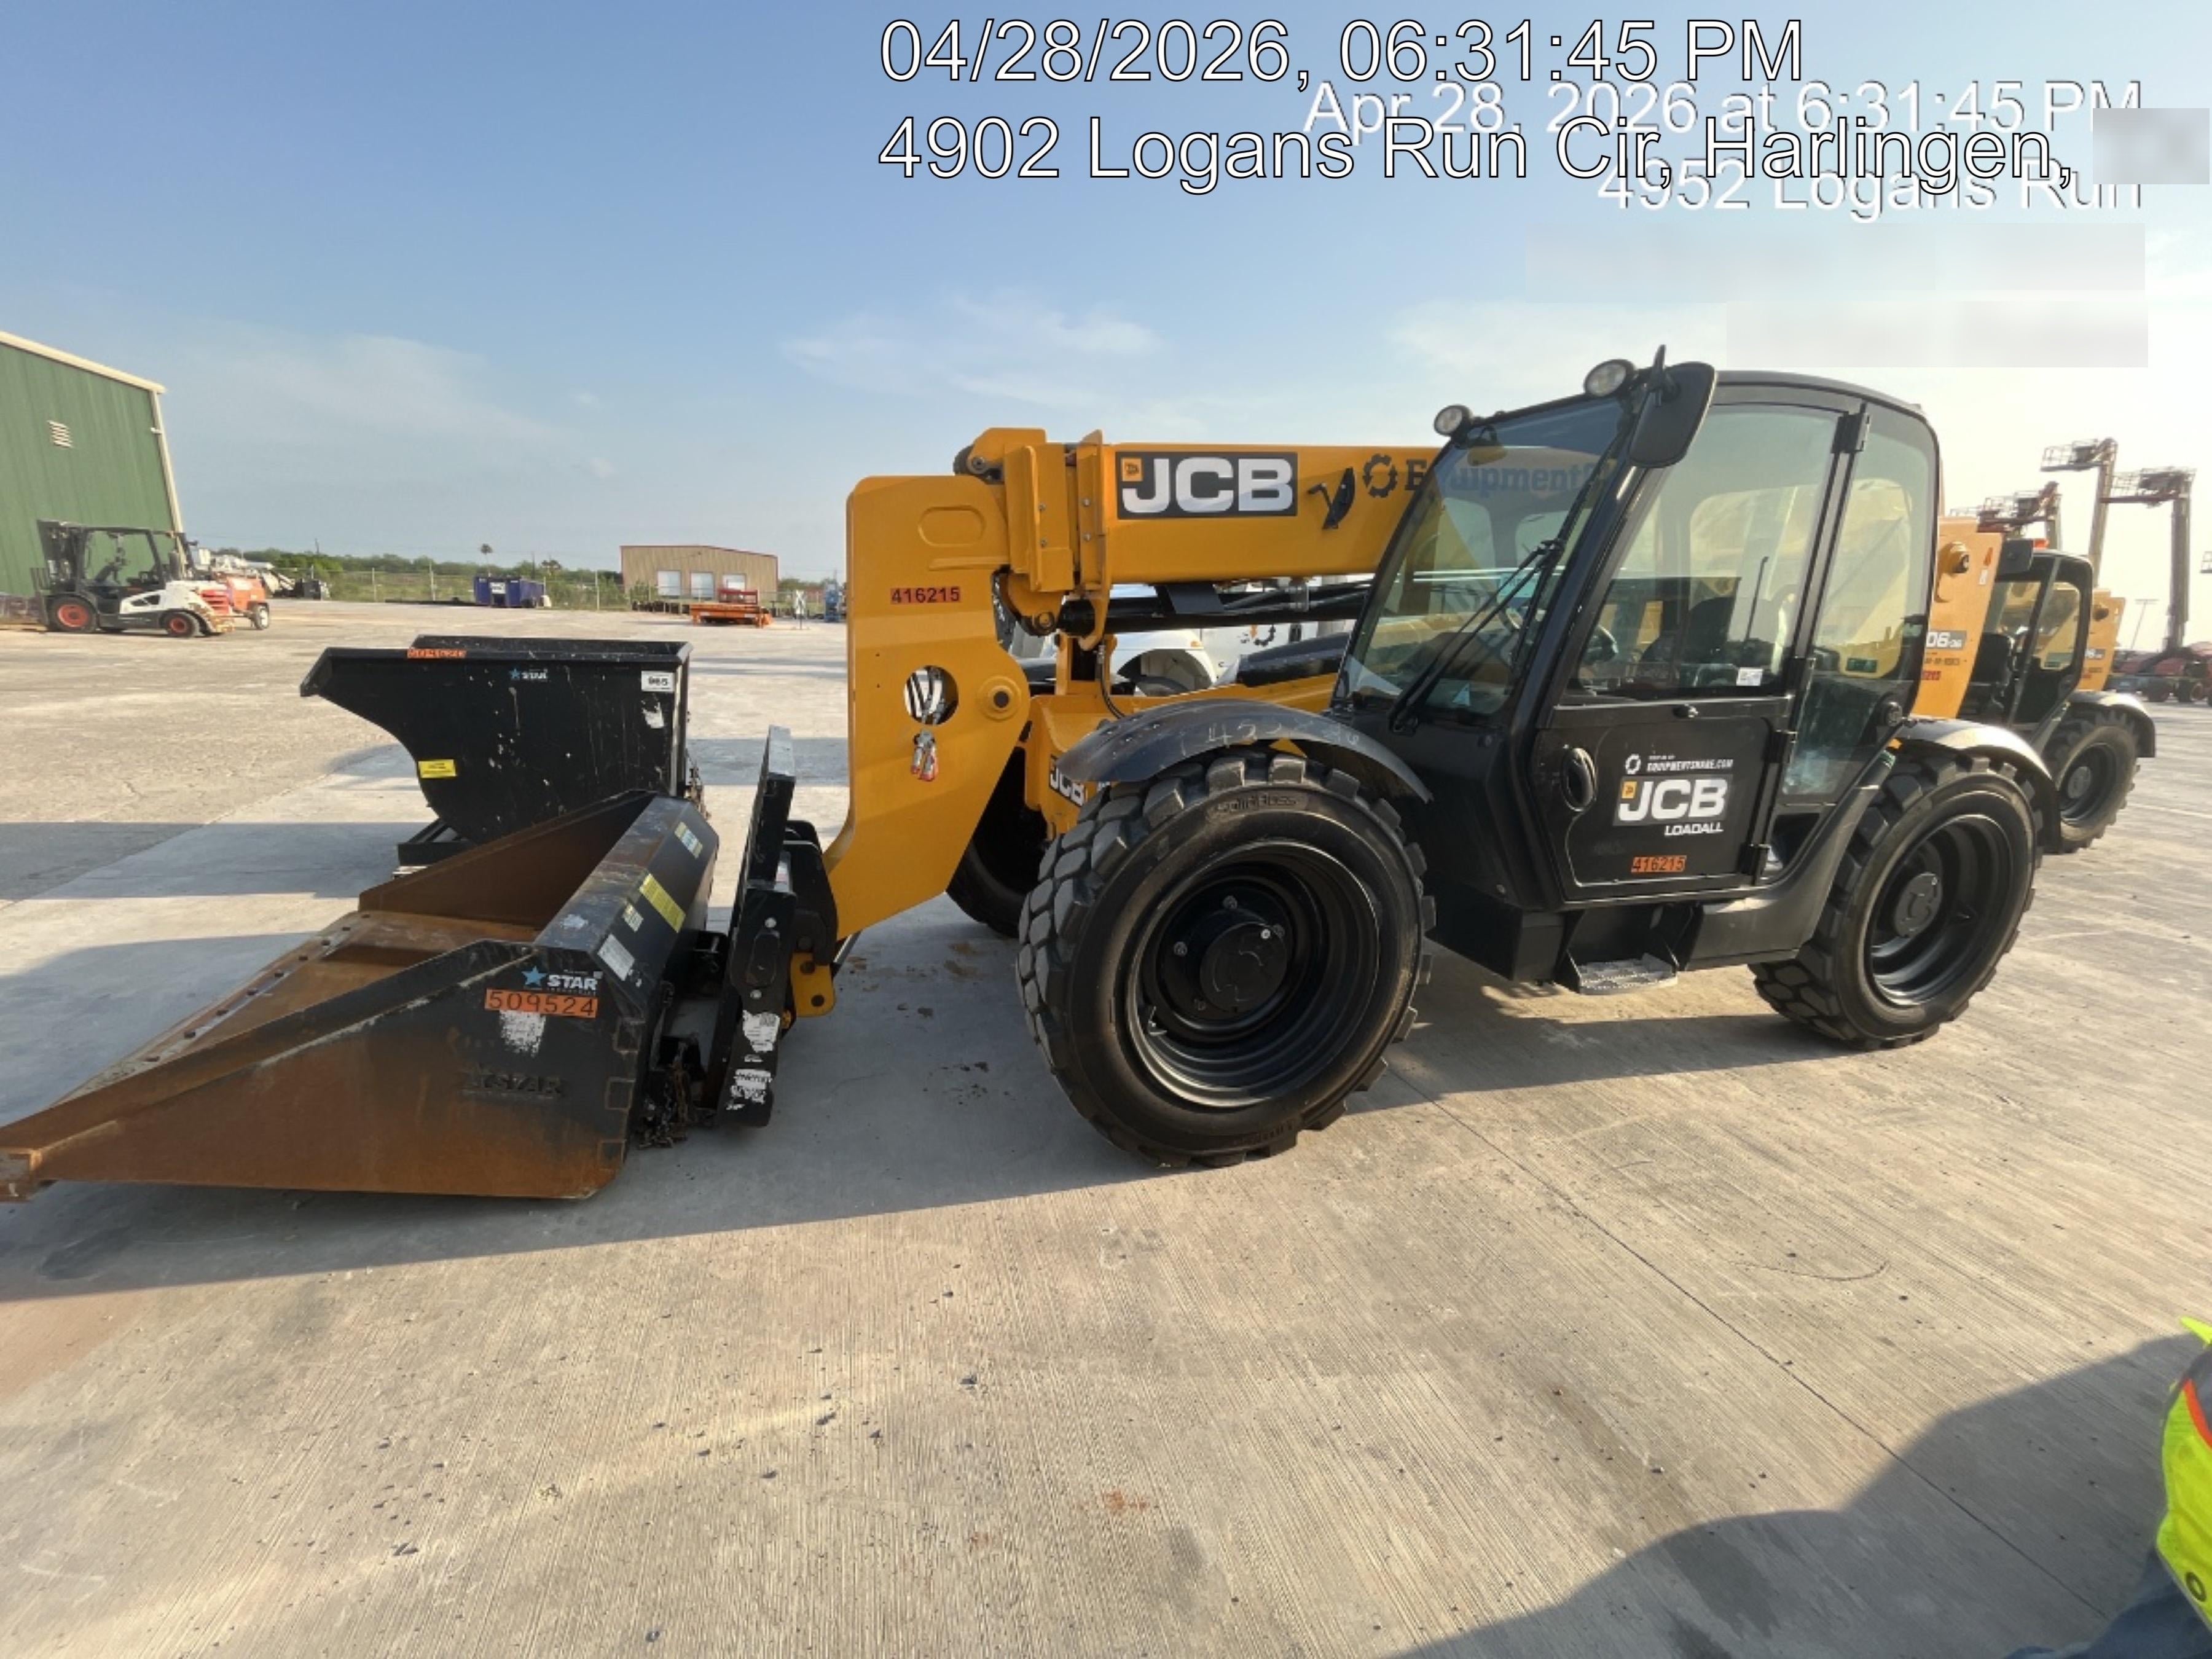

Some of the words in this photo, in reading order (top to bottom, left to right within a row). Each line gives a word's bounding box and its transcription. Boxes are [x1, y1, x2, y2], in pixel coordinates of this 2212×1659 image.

[1122, 457, 1293, 513] JCB
[892, 586, 960, 603] 416215
[1618, 779, 1728, 822] JCB
[1664, 822, 1724, 836] LOADALL
[1632, 857, 1685, 871] 416215
[547, 974, 598, 990] STAR
[489, 990, 594, 1016] 509524
